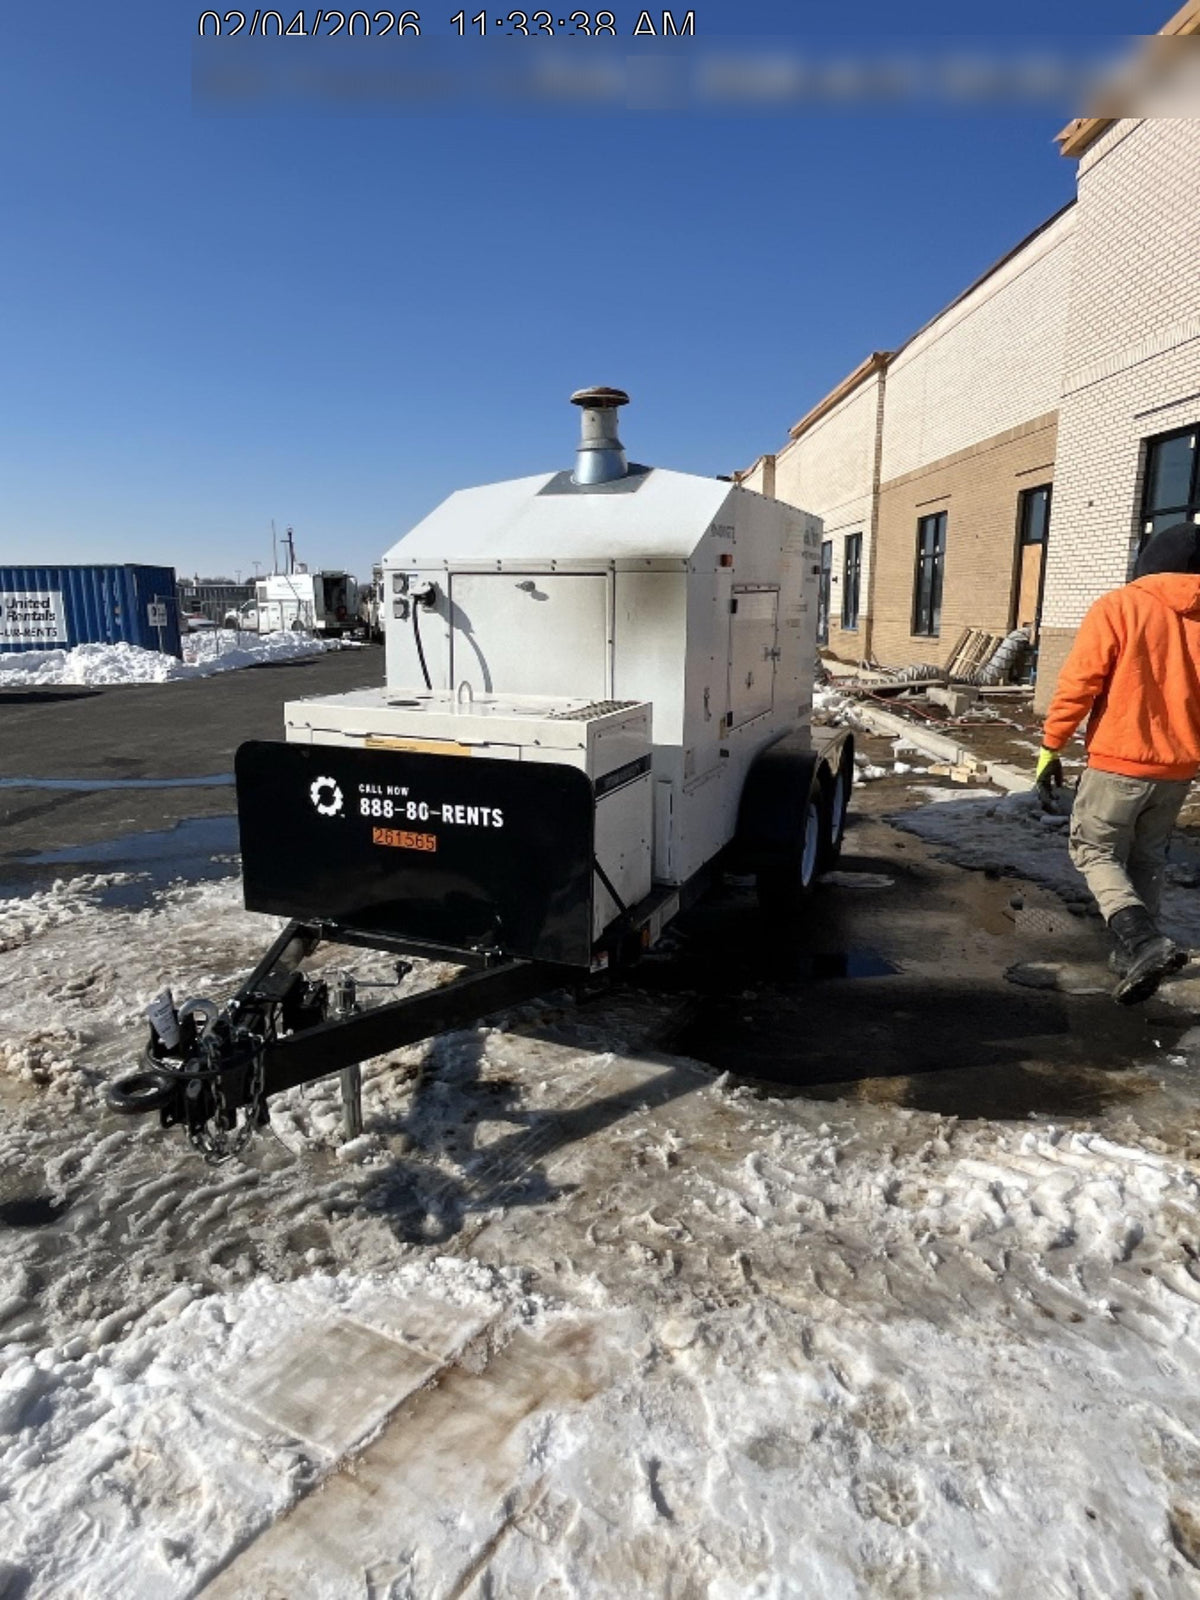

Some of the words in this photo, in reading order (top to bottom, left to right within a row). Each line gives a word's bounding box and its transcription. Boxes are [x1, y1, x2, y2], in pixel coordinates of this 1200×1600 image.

[5, 597, 50, 609] United
[7, 609, 56, 621] Rentals
[358, 783, 383, 795] CALL
[387, 785, 410, 796] NOW
[360, 797, 504, 828] 888-80-RENTS
[374, 828, 435, 850] 261565
